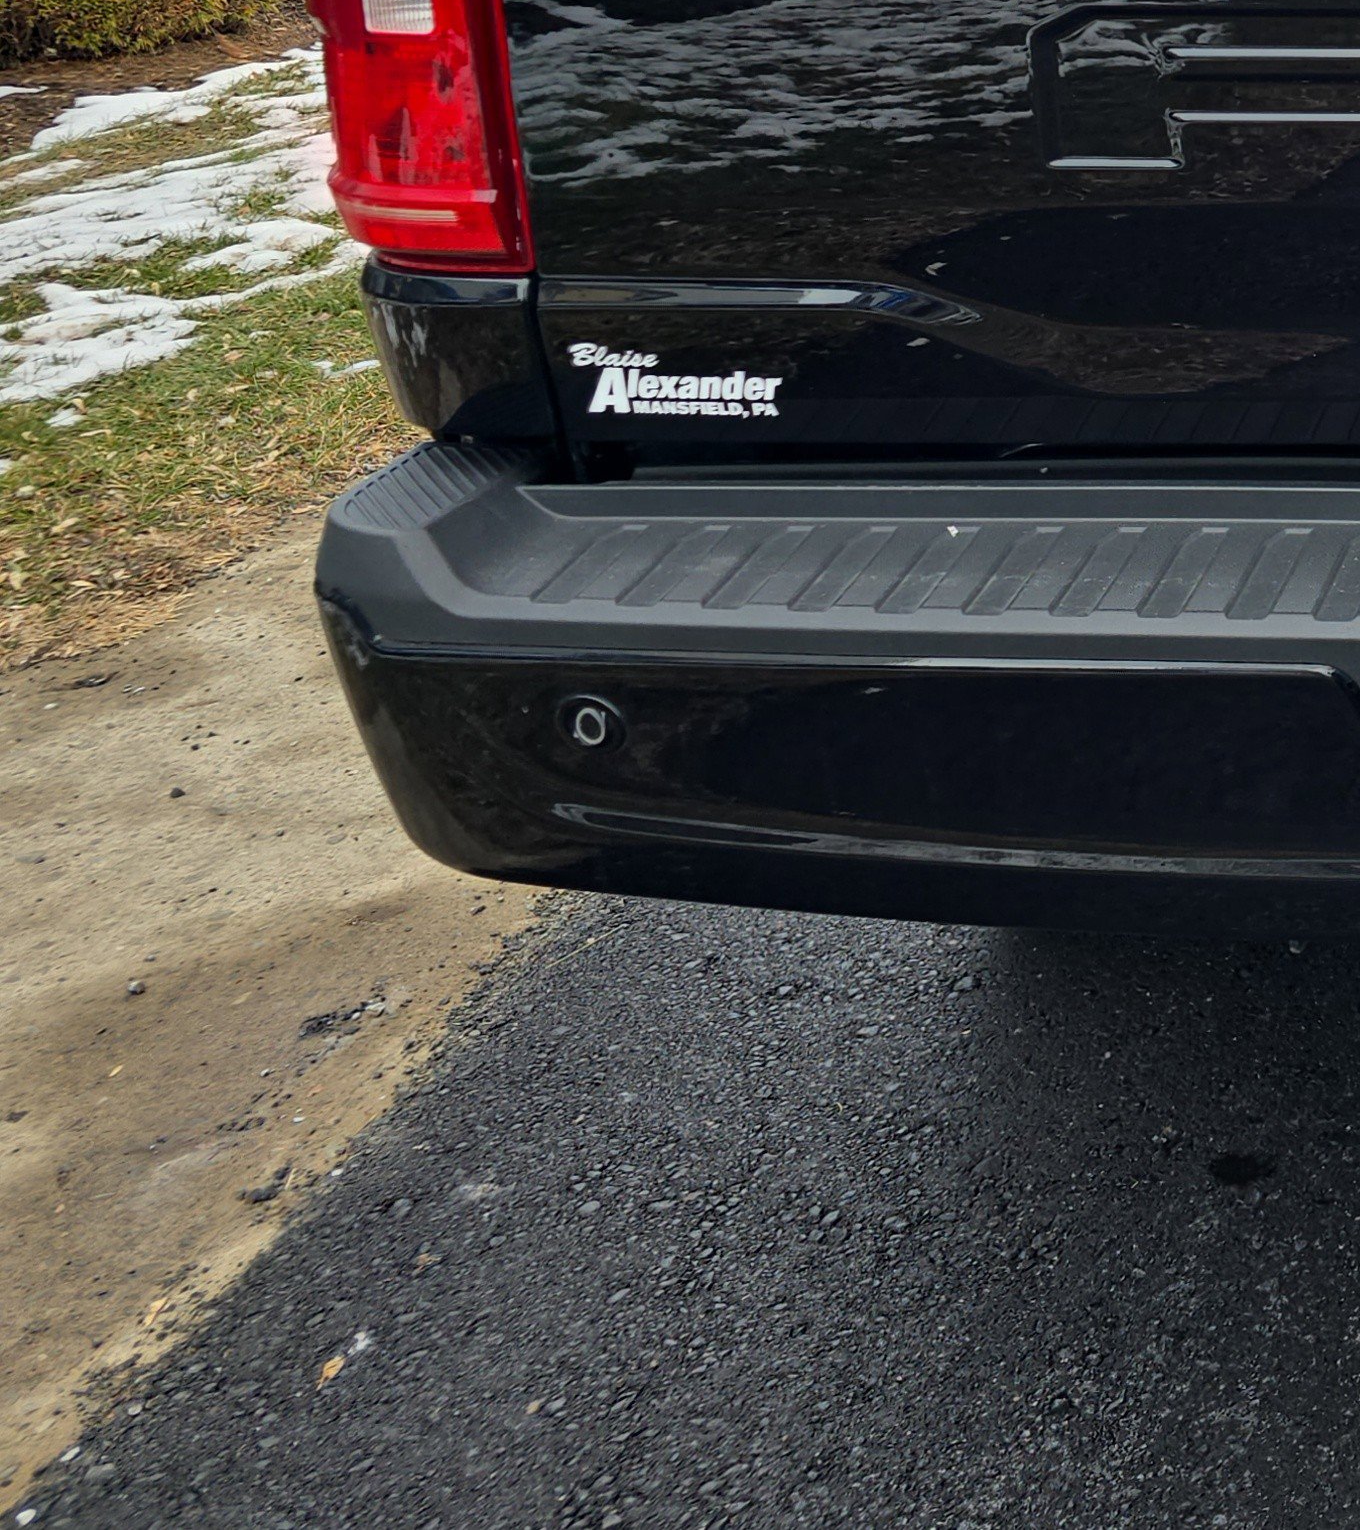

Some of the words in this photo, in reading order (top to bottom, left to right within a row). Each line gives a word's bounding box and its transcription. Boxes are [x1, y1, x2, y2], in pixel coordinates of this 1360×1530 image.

[567, 342, 660, 368] Blaise
[588, 367, 783, 414] Alexander
[632, 400, 750, 419] MANSFIELD,
[752, 402, 780, 417] PA
